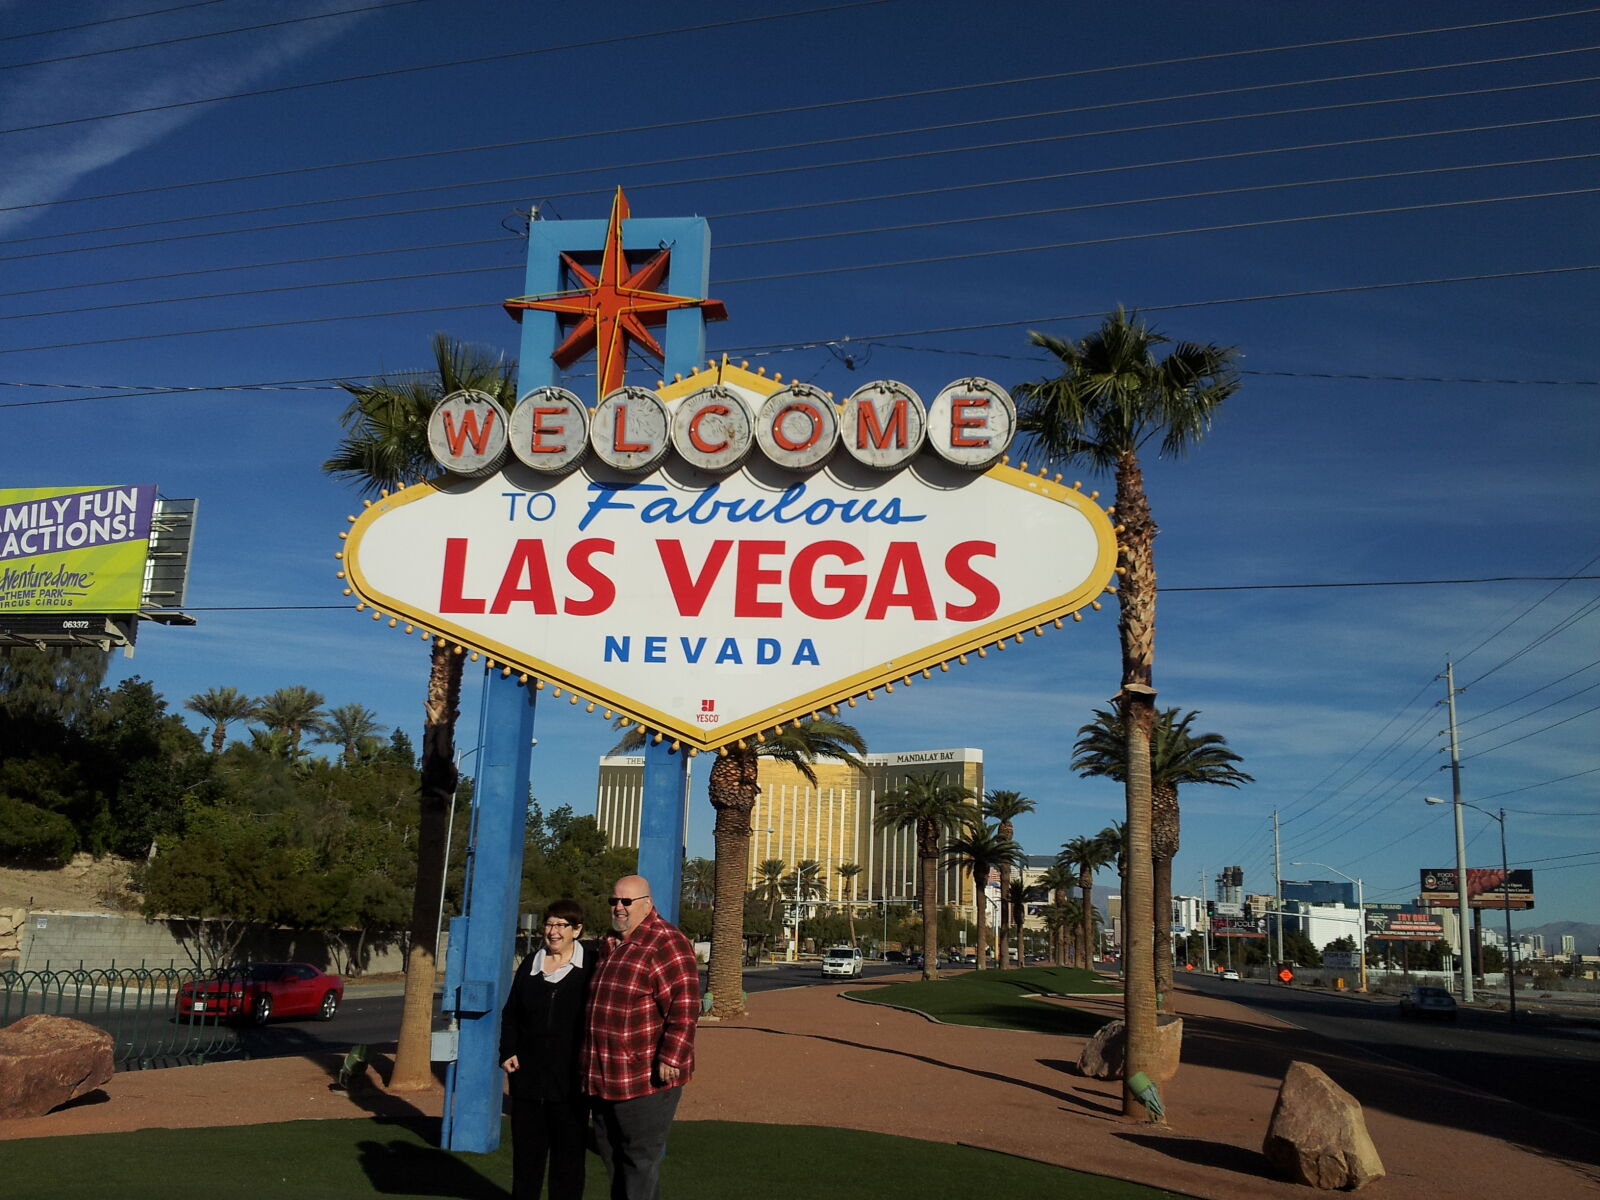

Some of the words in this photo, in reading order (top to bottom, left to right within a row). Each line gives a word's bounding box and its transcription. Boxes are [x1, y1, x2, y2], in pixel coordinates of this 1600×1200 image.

[441, 398, 991, 458] WELCOME
[78, 487, 138, 520] FUN
[502, 492, 557, 522] TO
[579, 482, 926, 532] Fabulous
[0, 513, 136, 558] ACTIONS!
[4, 589, 37, 601] THEME
[39, 588, 64, 598] PARK
[439, 537, 616, 617] LAS
[655, 539, 1001, 622] VEGAS
[35, 598, 73, 607] CIRCUS
[62, 620, 89, 629] 063372
[604, 635, 820, 665] NEVADA
[696, 714, 719, 723] YESCO
[896, 752, 939, 763] MANDALAY
[940, 751, 955, 760] BAY
